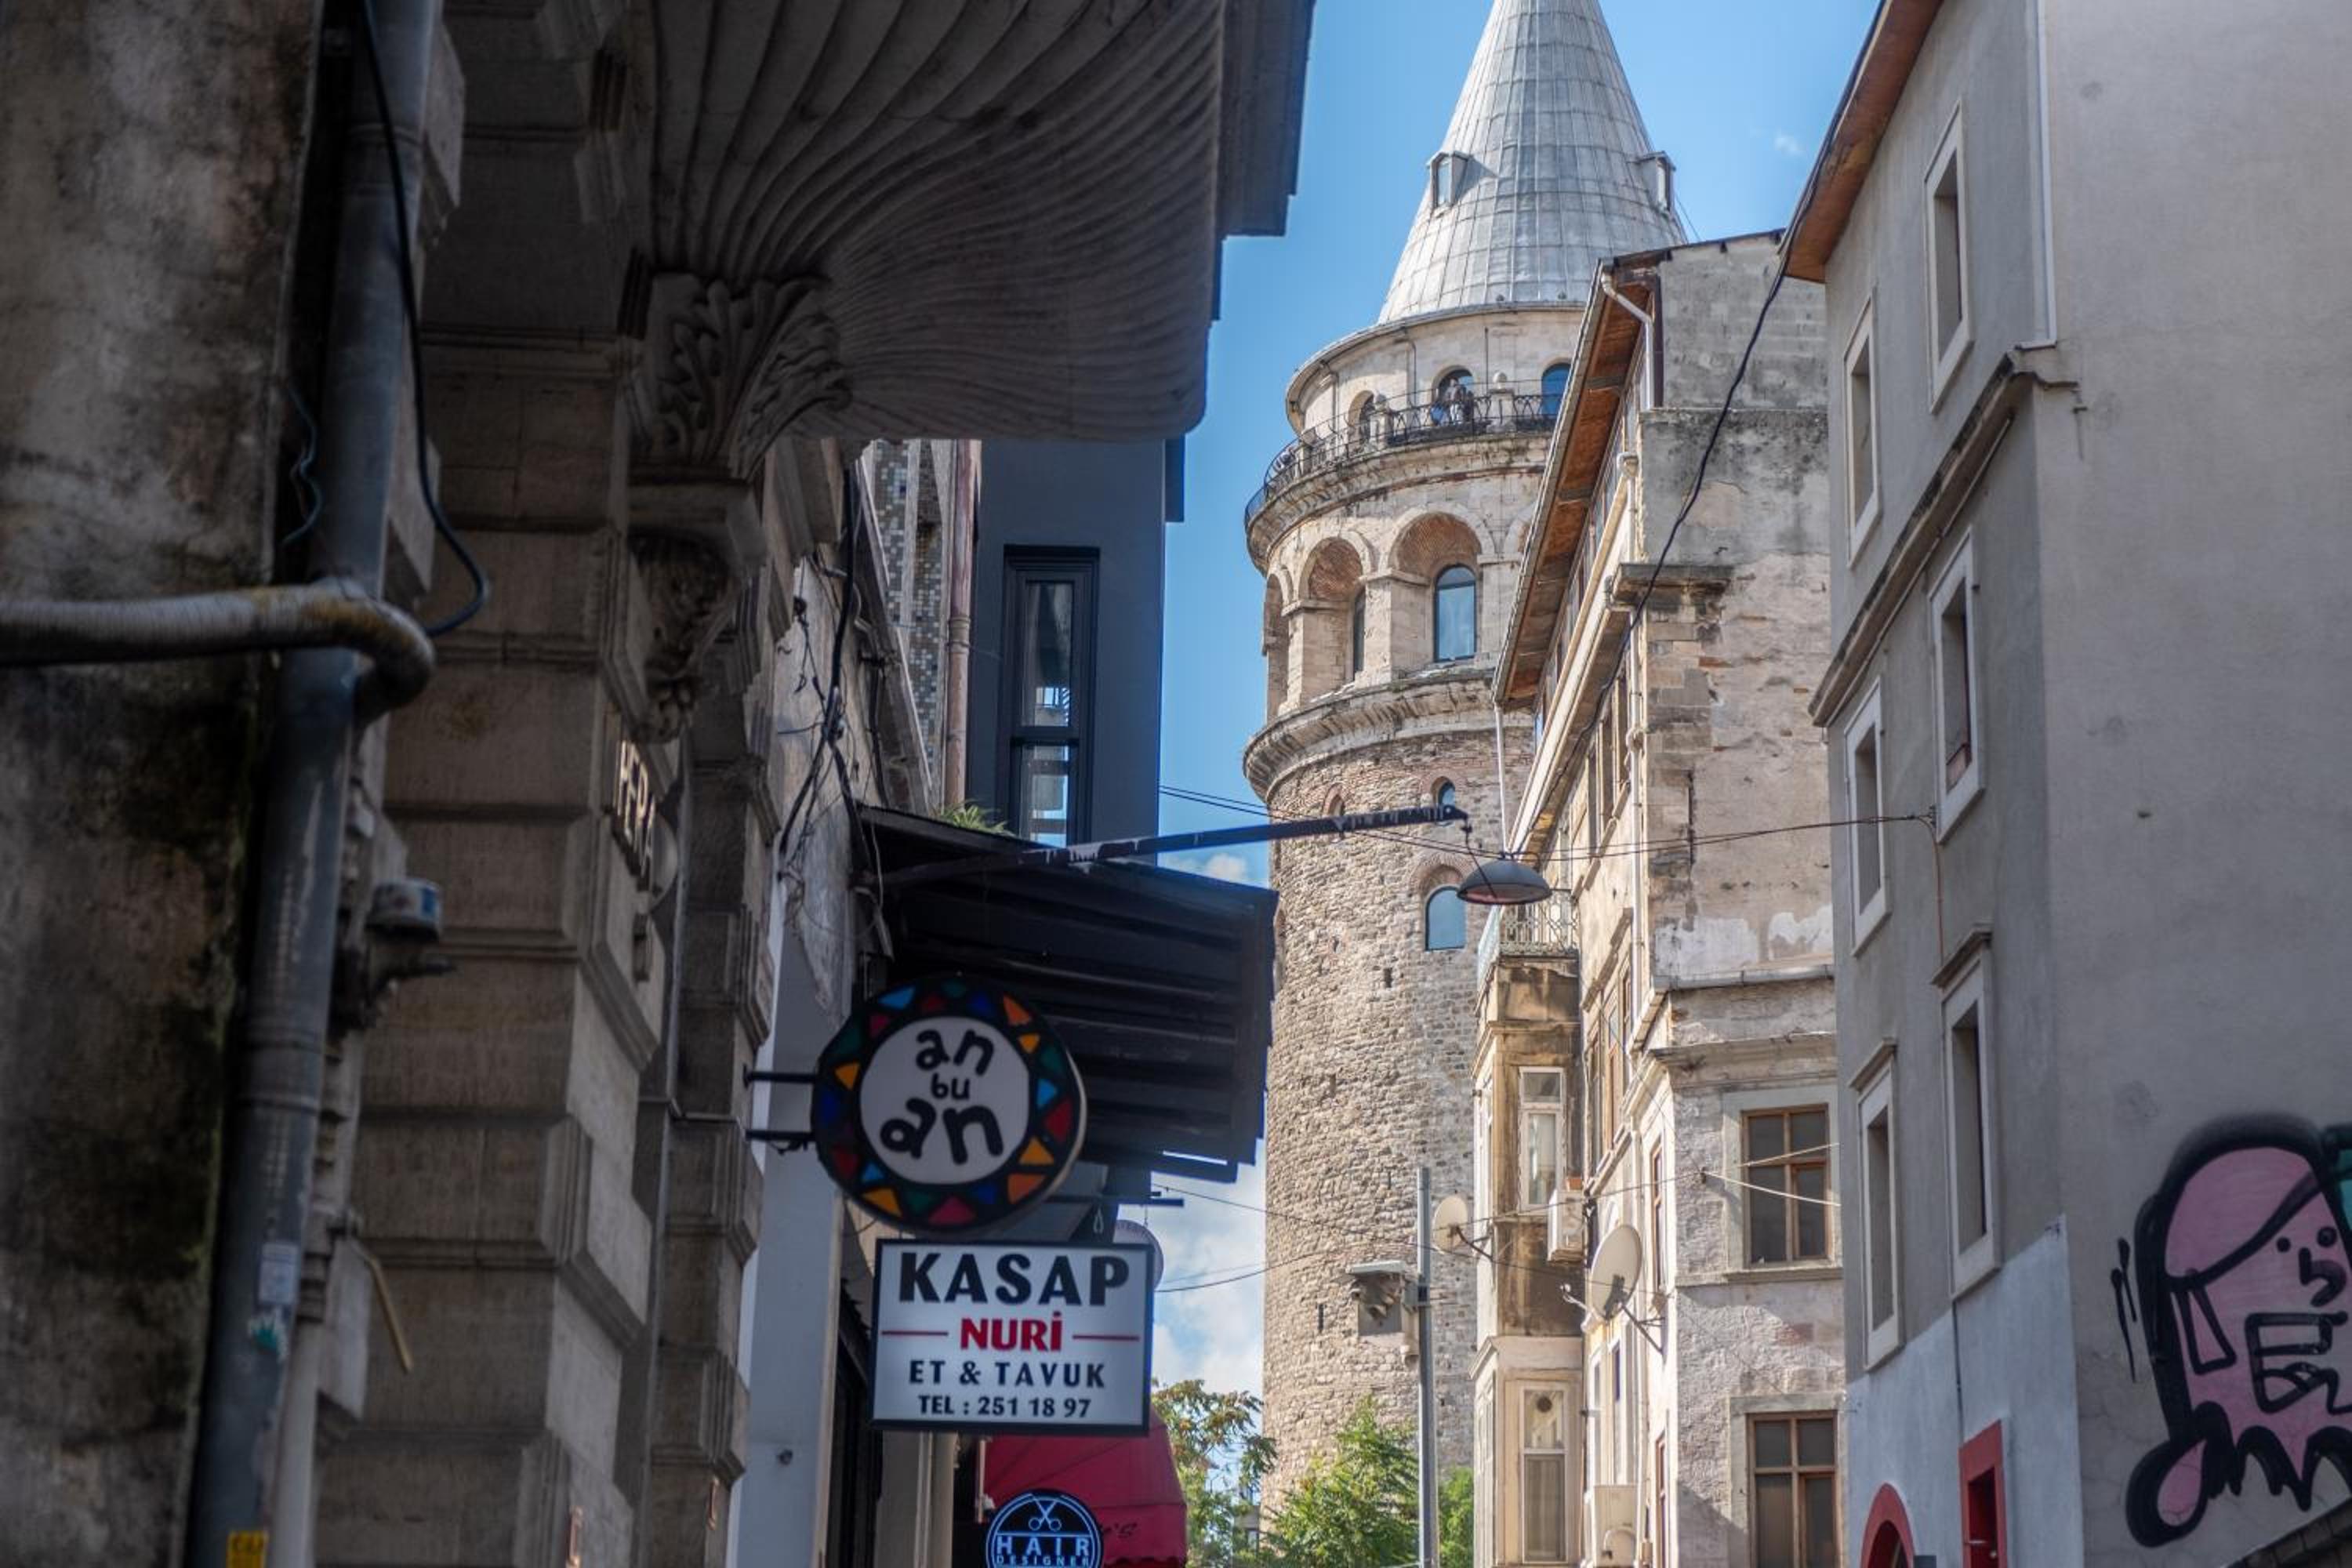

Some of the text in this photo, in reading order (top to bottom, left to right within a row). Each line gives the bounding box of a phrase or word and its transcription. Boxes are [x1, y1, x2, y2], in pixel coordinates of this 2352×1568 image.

[916, 1029, 994, 1076] an
[931, 1073, 970, 1100] bu
[880, 1098, 1004, 1165] an
[899, 1252, 1129, 1306] KASAP
[960, 1312, 1062, 1351] NURİ
[909, 1360, 1105, 1388] ET & TAVUK
[978, 1396, 1018, 1416] 251
[1029, 1398, 1055, 1417] 18
[1064, 1399, 1091, 1417] 97
[996, 1536, 1090, 1555] HAIR
[996, 1555, 1089, 1566] DESIGNER
